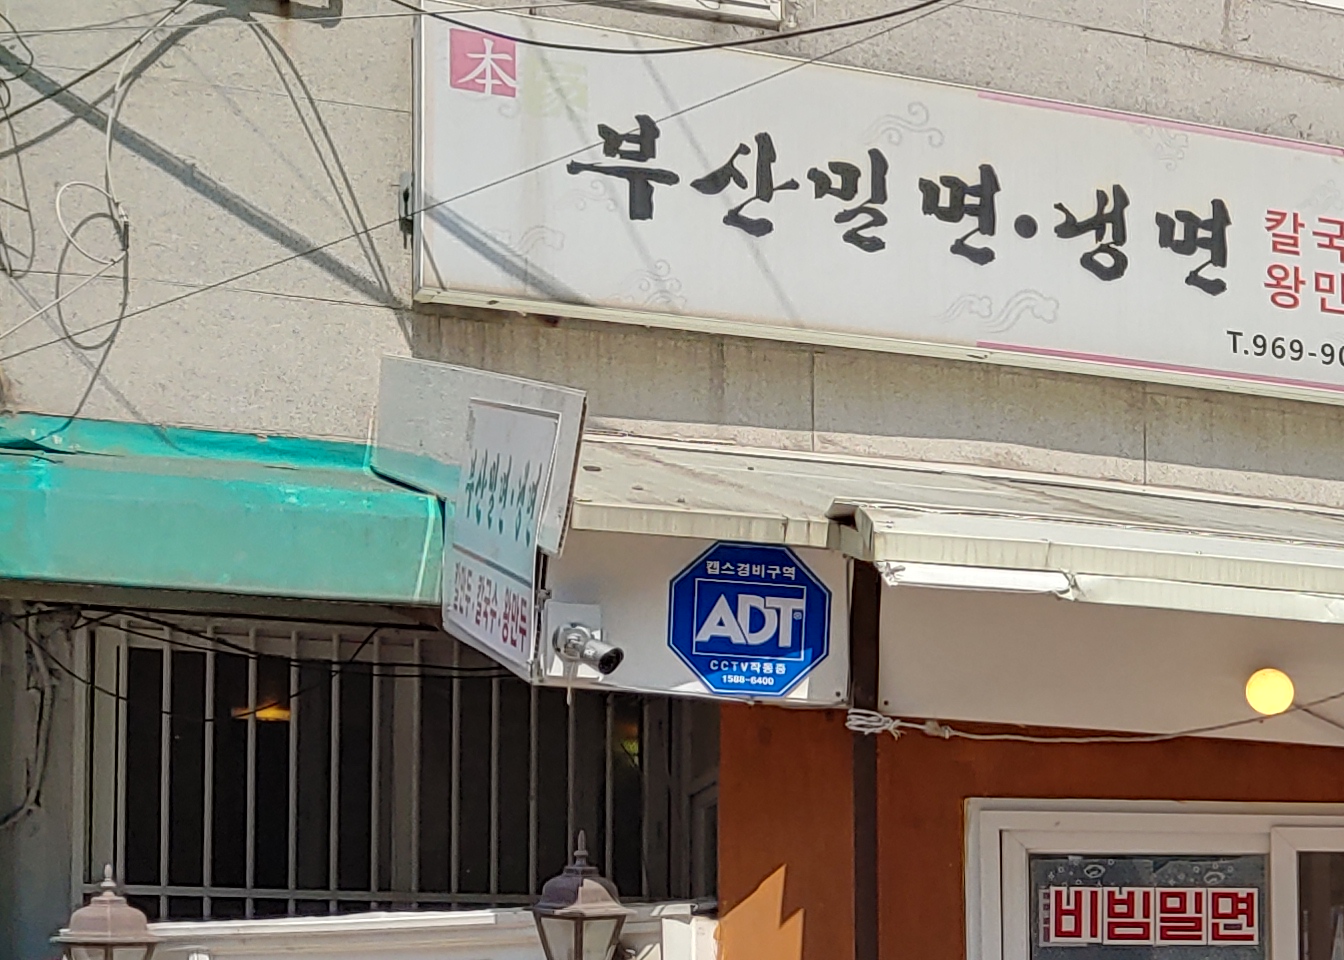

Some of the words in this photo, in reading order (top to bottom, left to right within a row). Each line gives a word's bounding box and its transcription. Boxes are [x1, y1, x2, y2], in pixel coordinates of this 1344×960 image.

[705, 560, 796, 581] 캡스경비구역
[694, 593, 806, 648] ADT
[721, 674, 775, 686] 1588-6400
[1051, 887, 1258, 944] 비빔밀면
